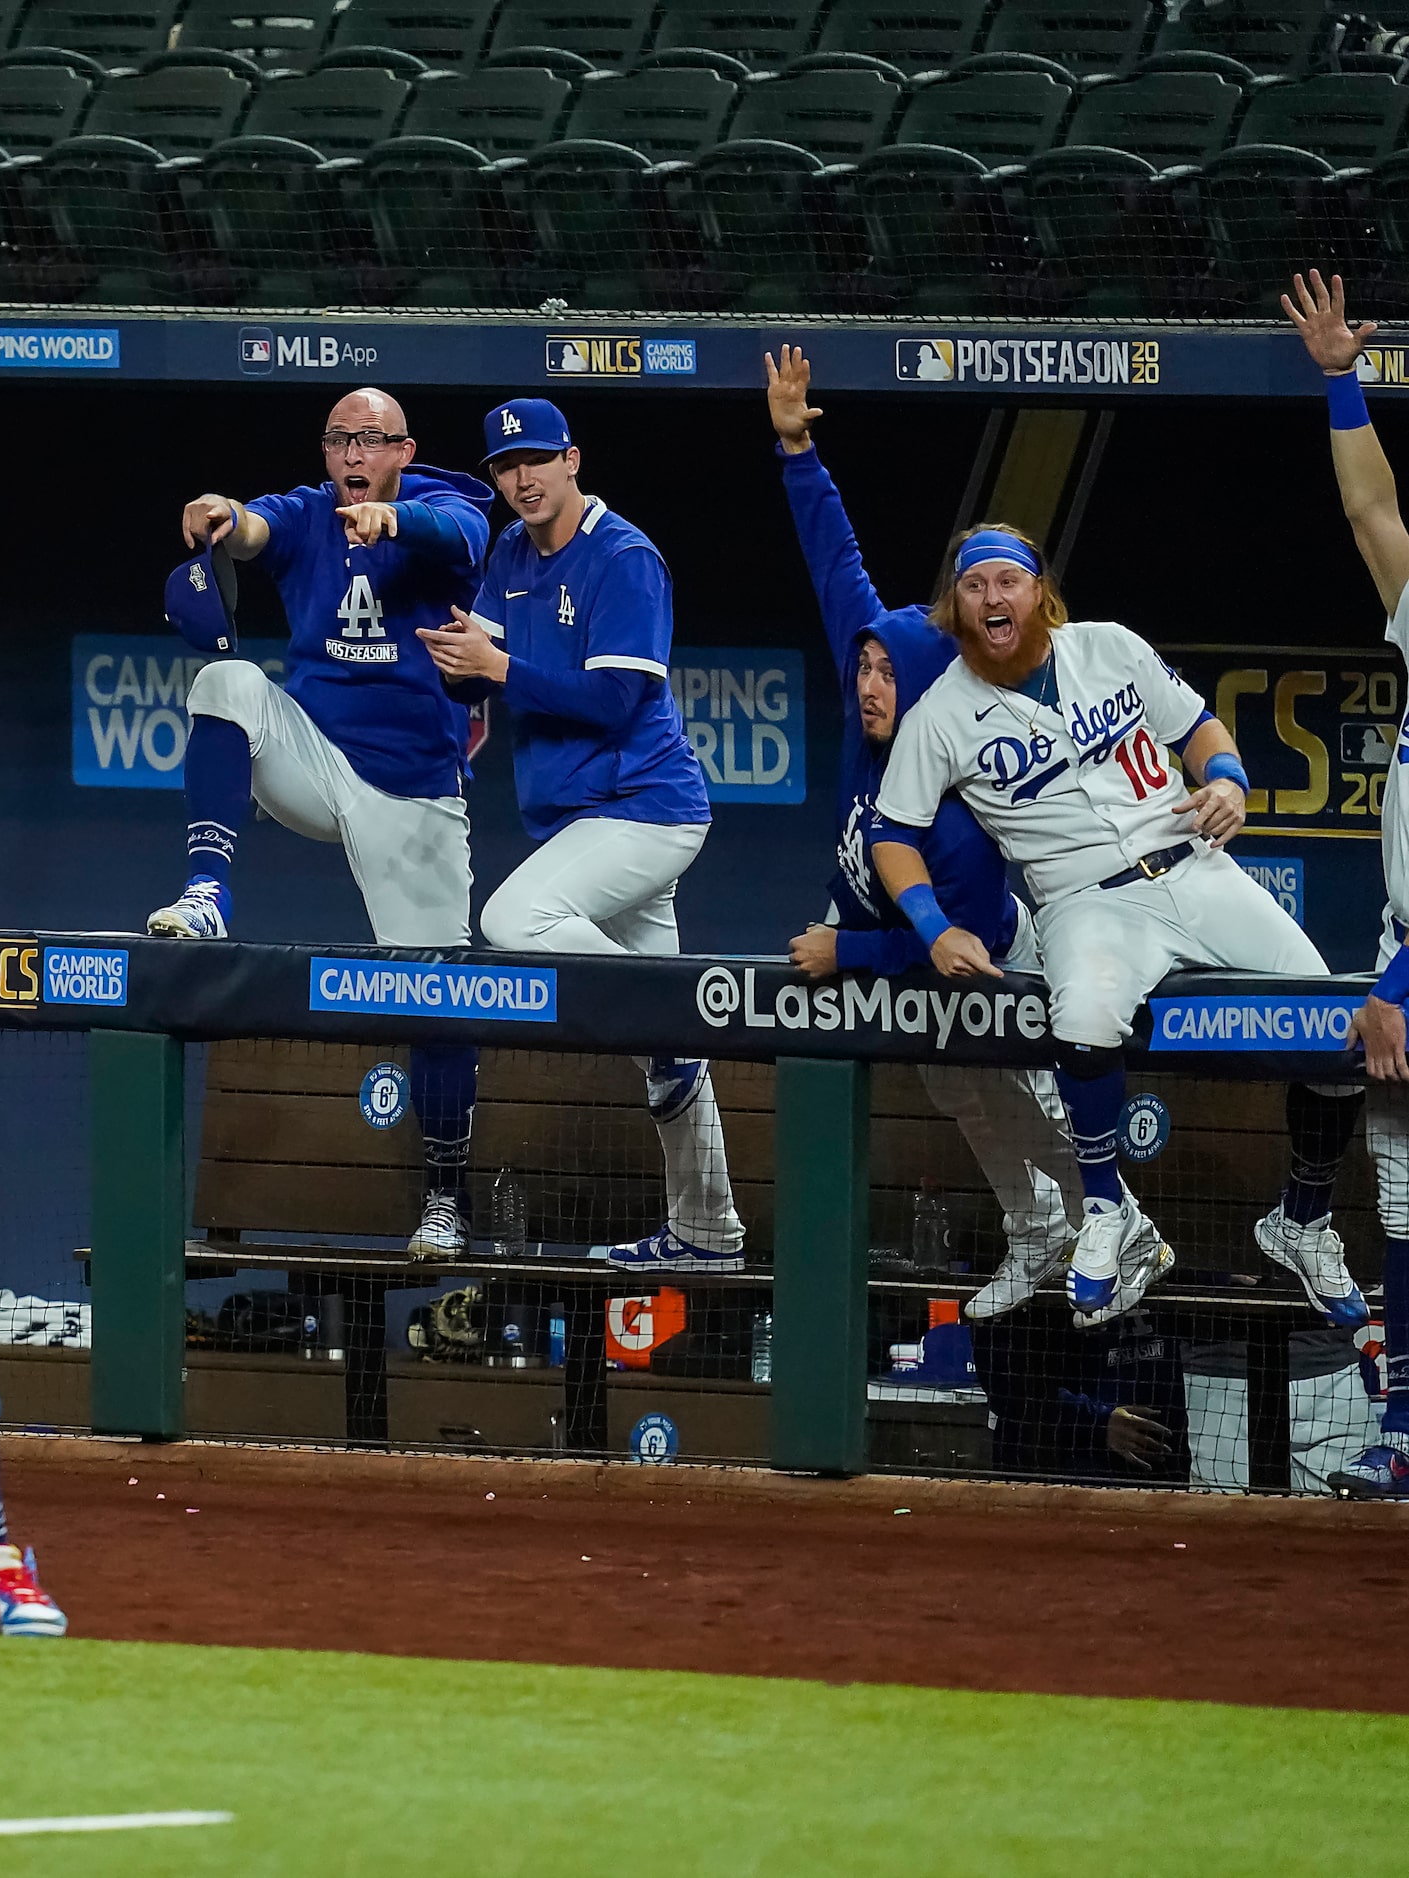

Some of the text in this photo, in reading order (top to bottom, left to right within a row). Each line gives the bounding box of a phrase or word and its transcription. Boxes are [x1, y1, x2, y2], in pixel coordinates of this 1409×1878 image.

[41, 336, 114, 360] WORLD
[277, 336, 378, 367] MLB App
[592, 340, 641, 373] NLCS
[646, 343, 693, 357] CAMPING
[646, 356, 693, 371] WORLD
[957, 339, 1160, 384] POSTSEASON 20
[1131, 362, 1160, 385] 20
[501, 408, 523, 436] LA
[557, 584, 575, 627] LA
[326, 641, 391, 661] POSTSEASON
[671, 667, 790, 722] PING
[1340, 671, 1398, 715] 20
[687, 721, 790, 786] RLD
[977, 680, 1145, 803] Dodgers
[1114, 728, 1168, 801] 10
[48, 954, 123, 977] CAMPING
[48, 974, 123, 1000] WORLD
[319, 968, 549, 1011] CAMPING WORLD
[696, 966, 1048, 1050] @LasMayore
[1162, 1007, 1295, 1040] CAMPING
[1137, 1117, 1153, 1141] 6'
[608, 1296, 654, 1351] G
